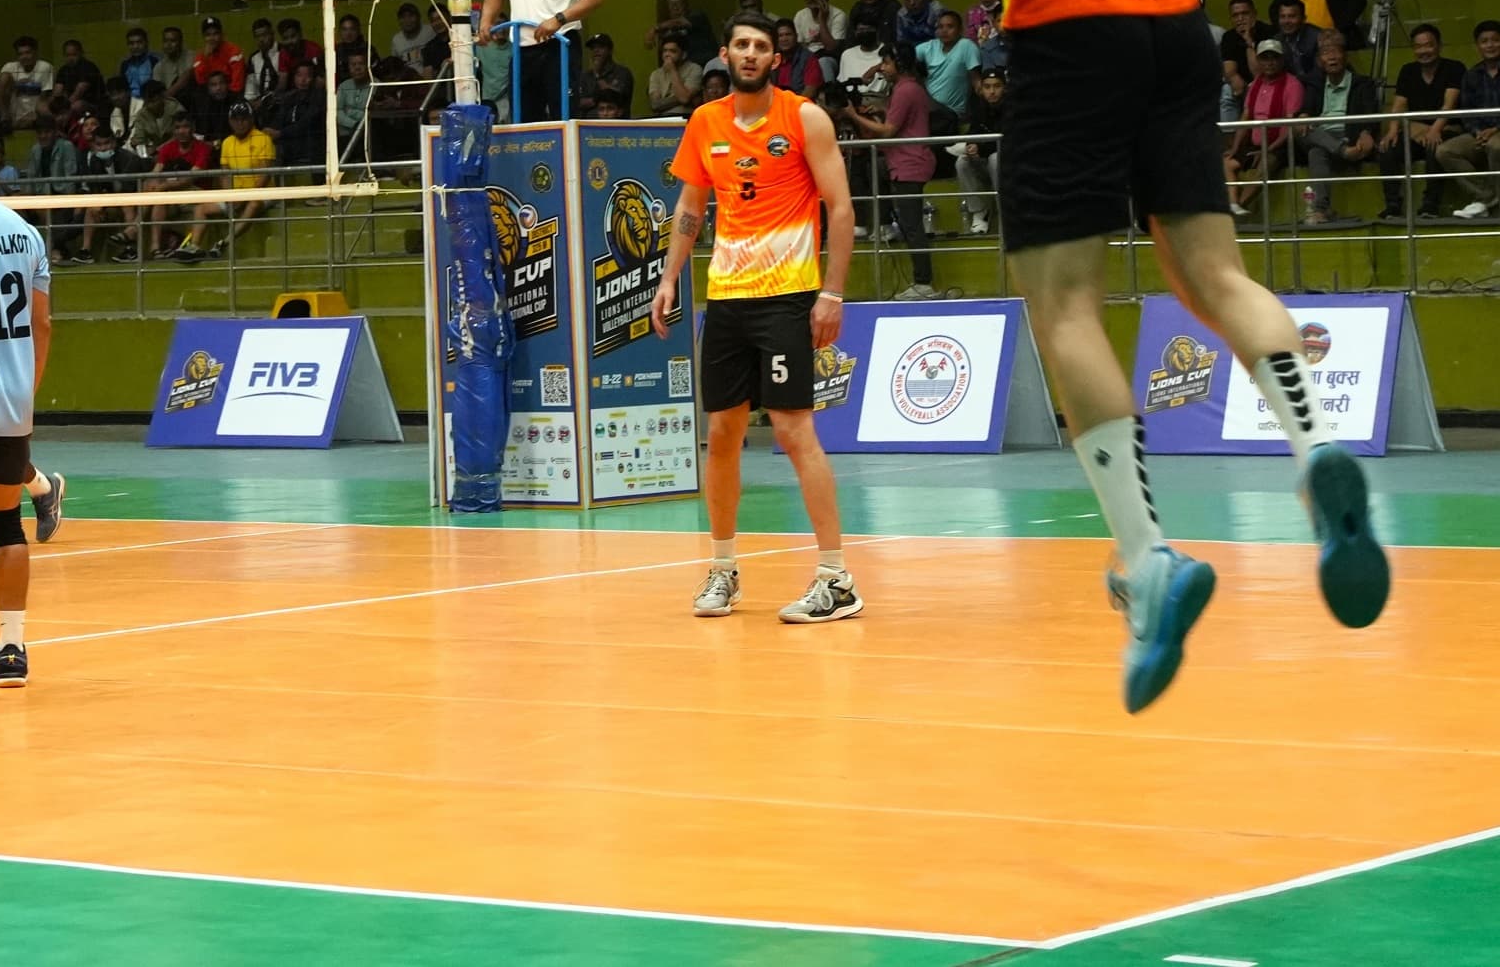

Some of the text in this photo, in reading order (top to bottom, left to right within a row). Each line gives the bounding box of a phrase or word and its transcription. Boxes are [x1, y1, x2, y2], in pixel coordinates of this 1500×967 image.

[514, 257, 552, 287] CUP
[596, 255, 668, 305] LIONS CU
[508, 284, 548, 309] NATIONAL
[601, 285, 658, 321] LIONS INTERNATI
[248, 362, 320, 387] FIVB
[771, 354, 789, 383] 5
[829, 374, 850, 387] CUP
[1150, 368, 1211, 391] LIONS CUP
[1326, 370, 1361, 389] बुक्स
